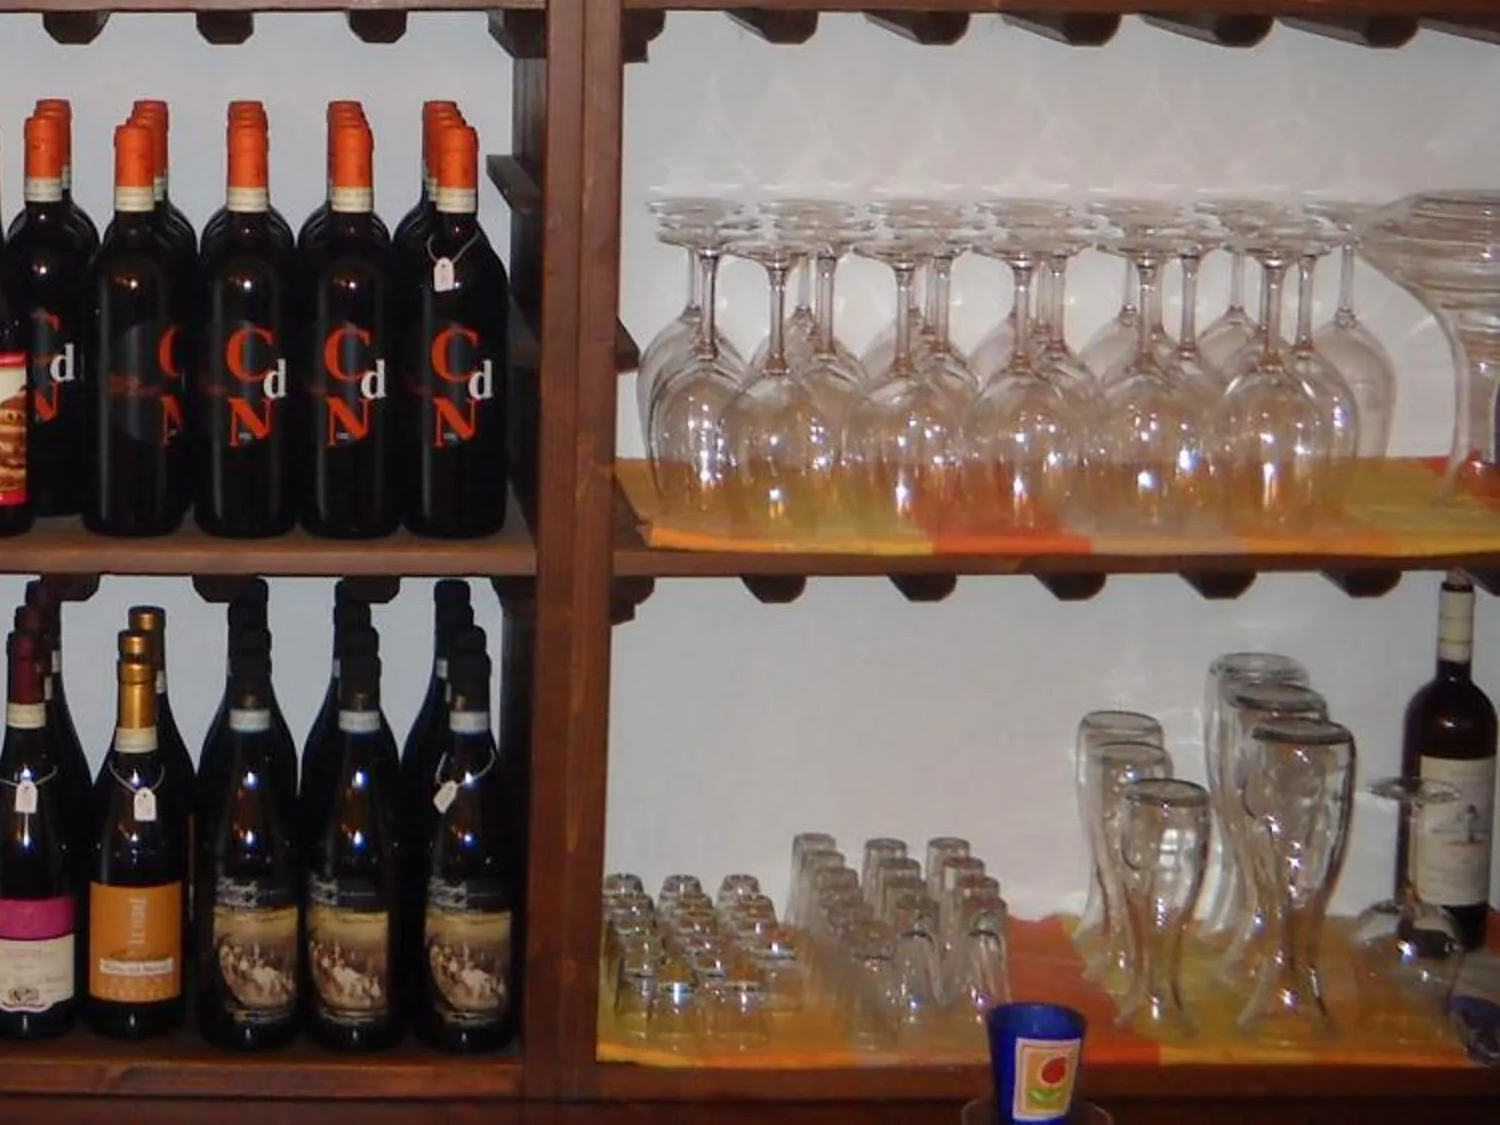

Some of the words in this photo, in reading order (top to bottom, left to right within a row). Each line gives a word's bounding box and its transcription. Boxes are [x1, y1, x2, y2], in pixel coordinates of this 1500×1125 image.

[49, 343, 75, 382] d
[225, 325, 274, 382] C
[323, 325, 371, 382] C
[430, 325, 479, 382] C
[263, 358, 287, 399] d
[360, 358, 387, 399] d
[467, 360, 494, 400] d
[228, 397, 273, 446] N
[326, 396, 372, 446] N
[433, 397, 478, 446] N
